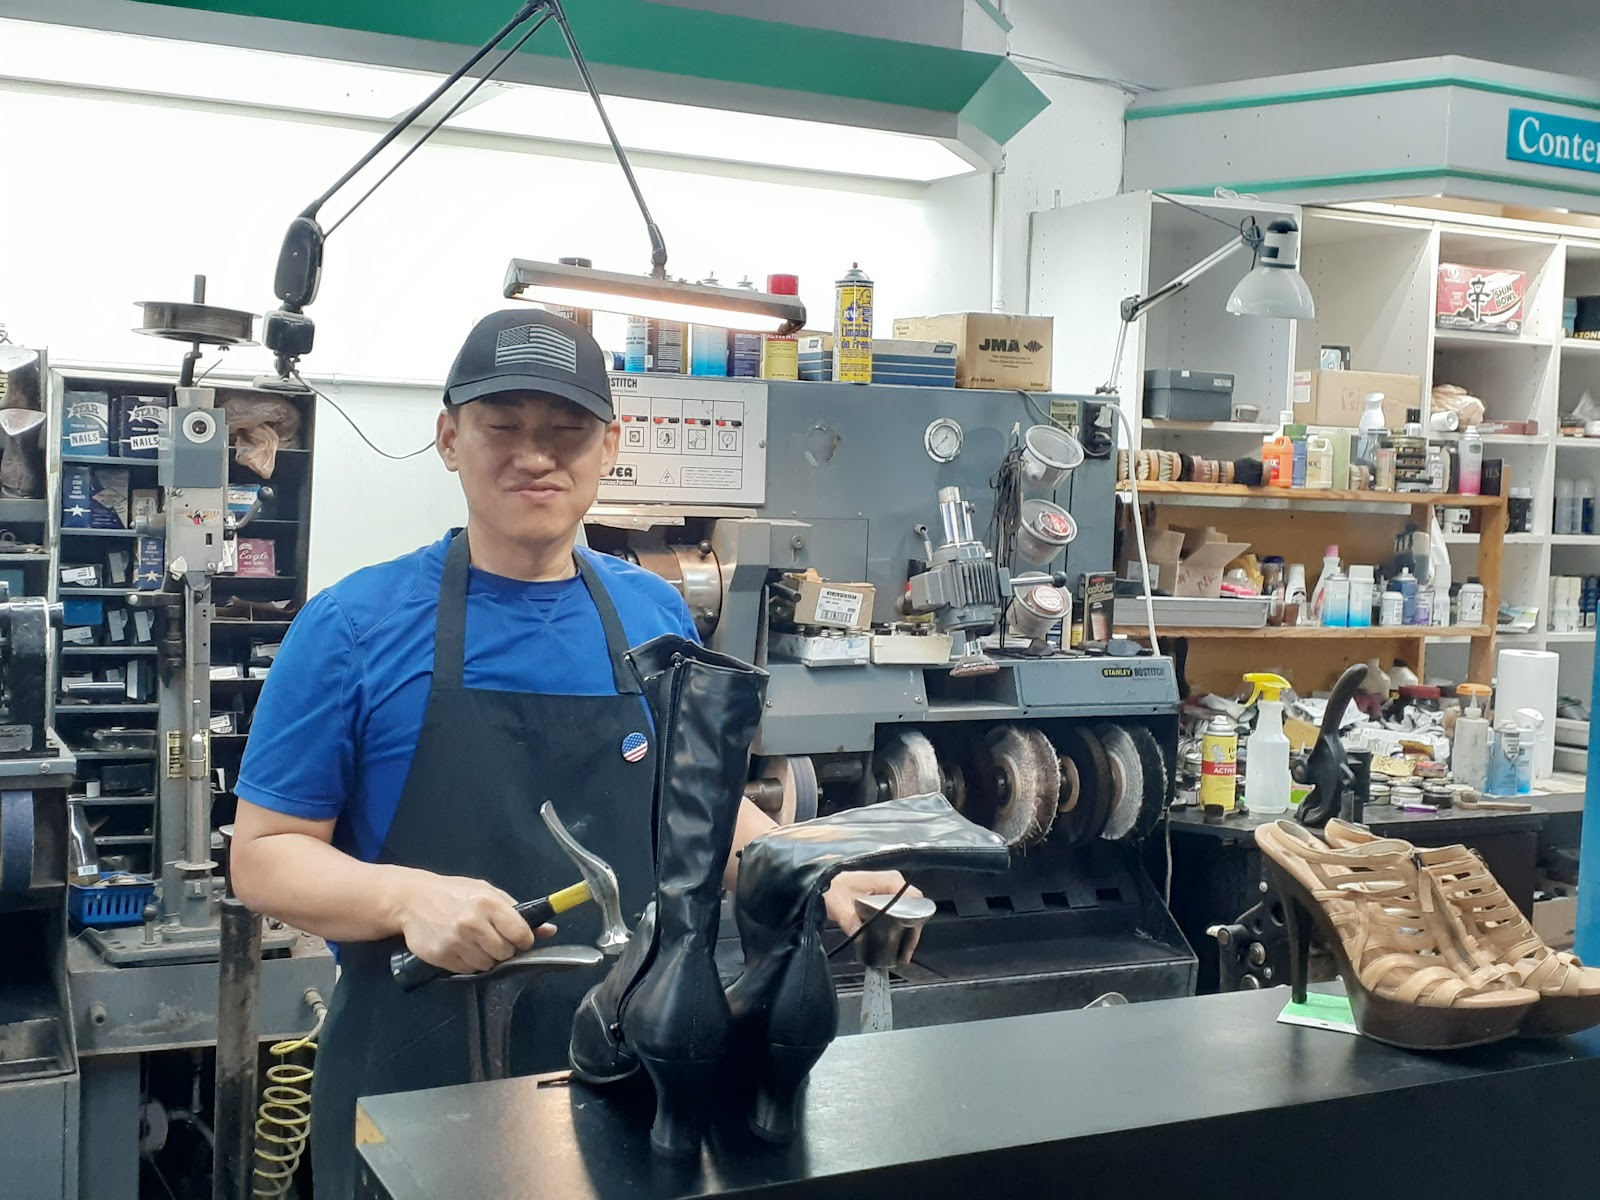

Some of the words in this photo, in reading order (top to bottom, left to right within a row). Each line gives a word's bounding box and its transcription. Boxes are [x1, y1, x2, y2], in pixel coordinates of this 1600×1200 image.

[1494, 284, 1512, 299] SHIN
[1496, 291, 1517, 308] BOWL
[979, 338, 1020, 353] JMA
[609, 377, 638, 388] STITCH
[73, 404, 100, 415] STAR
[134, 407, 160, 418] STAR
[71, 433, 99, 444] NAILS
[132, 436, 159, 448] NAILS
[239, 550, 269, 561] Eagle
[1134, 667, 1165, 677] BOSTITCH
